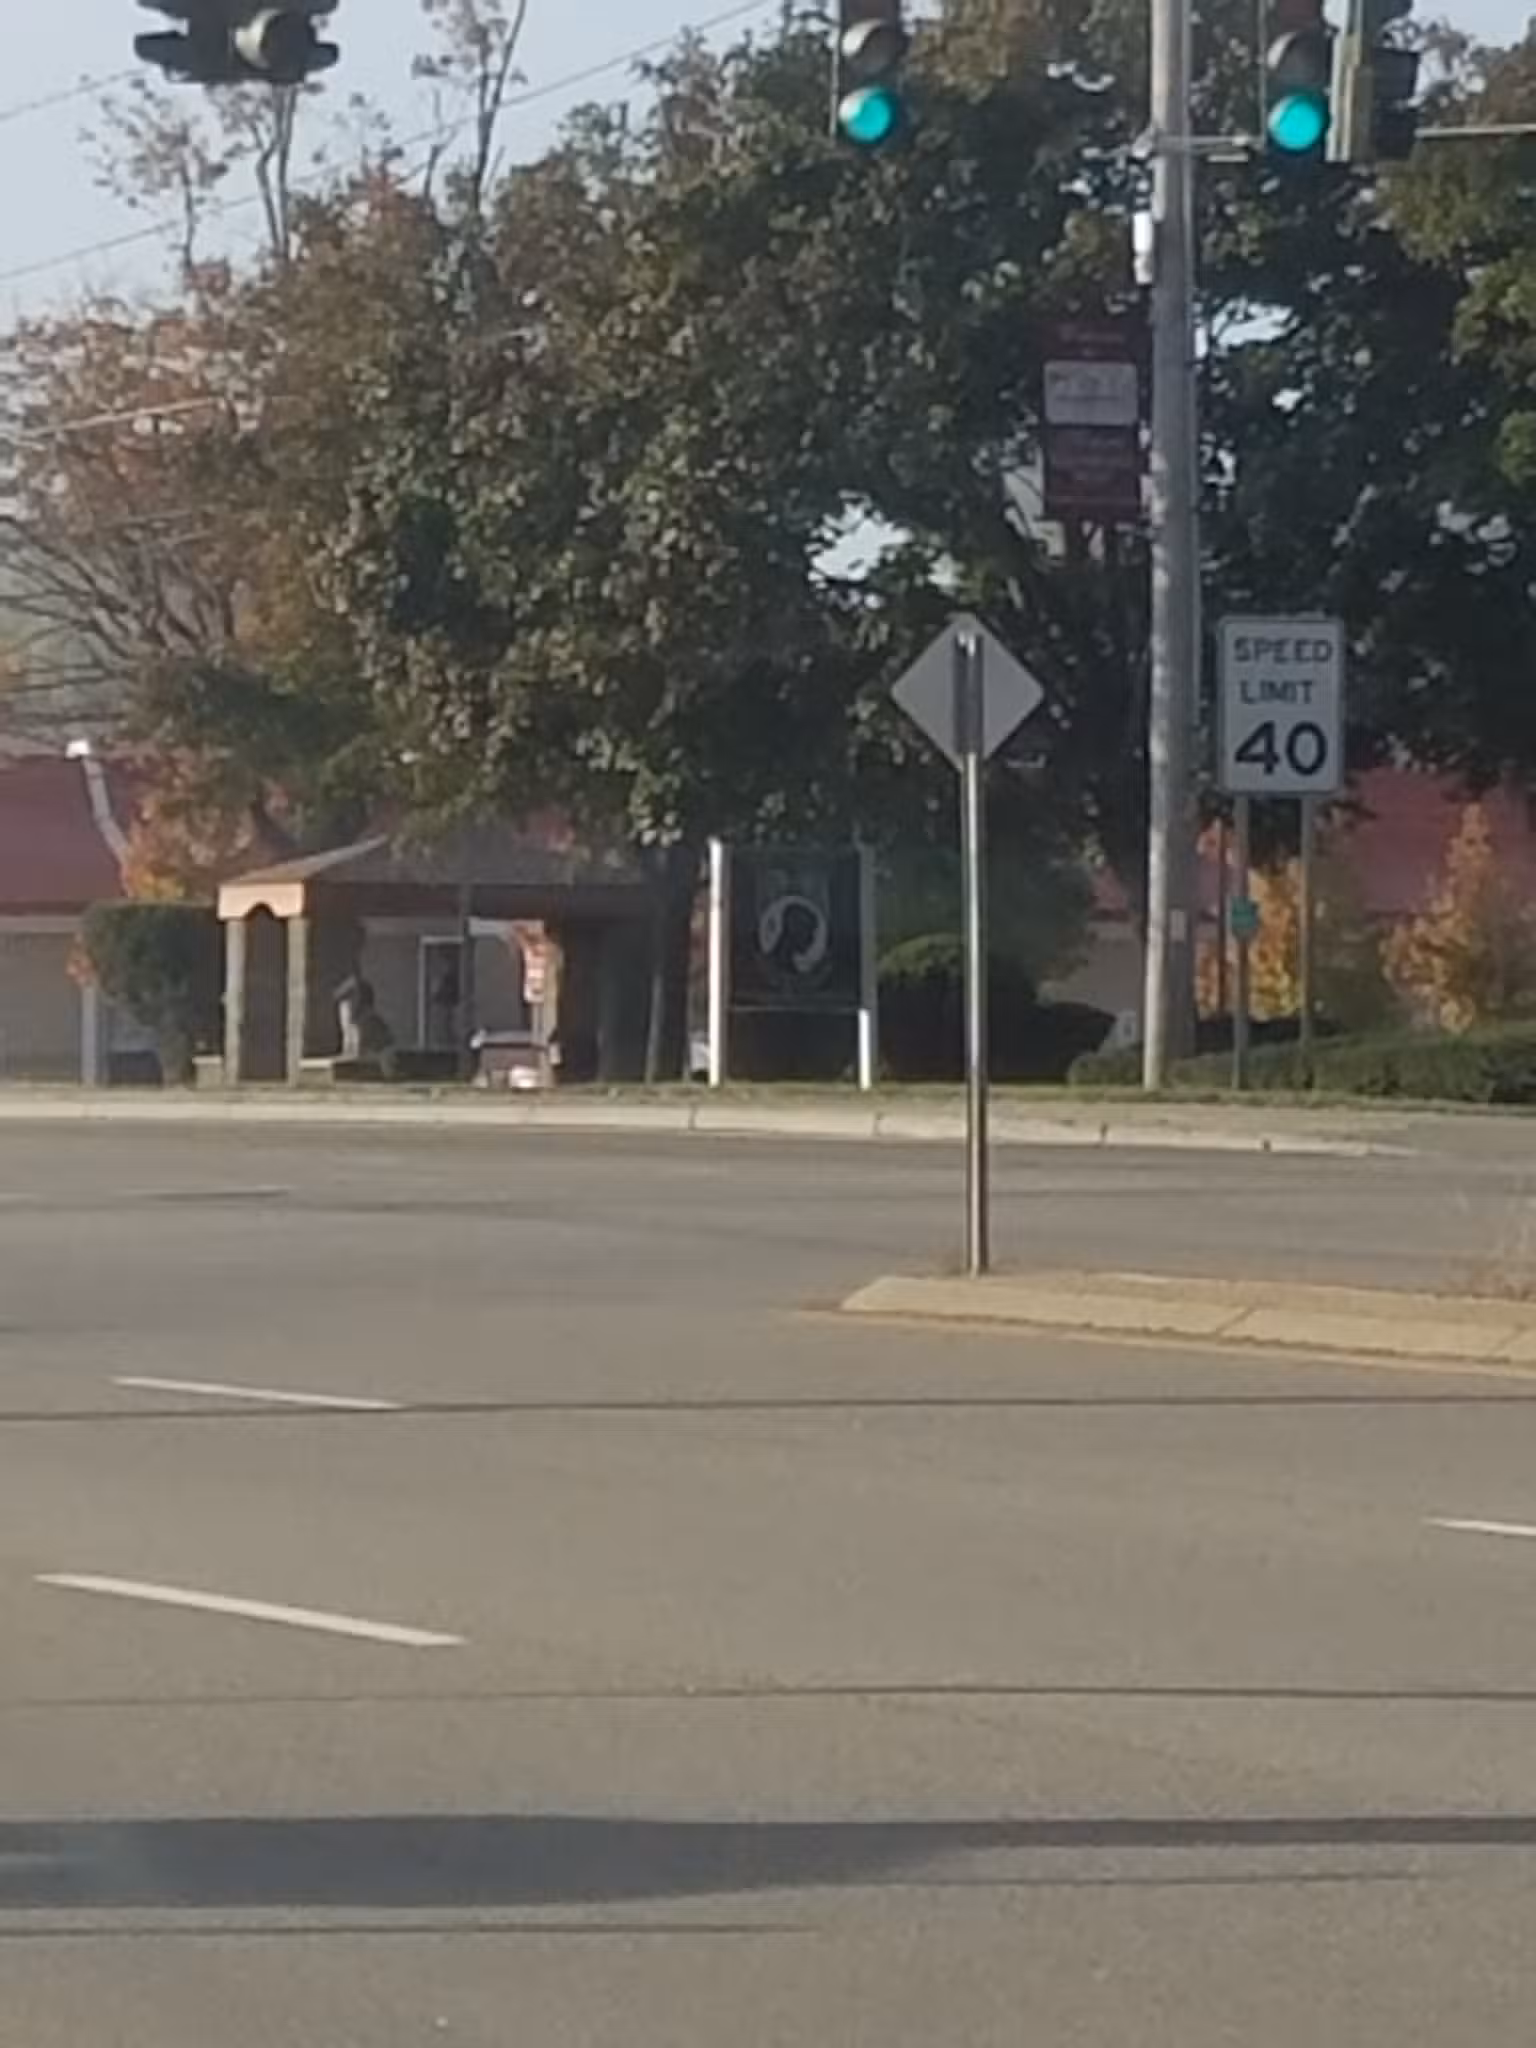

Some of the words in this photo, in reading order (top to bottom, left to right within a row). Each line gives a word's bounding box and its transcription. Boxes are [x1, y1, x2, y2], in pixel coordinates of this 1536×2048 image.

[1233, 637, 1333, 663] SPEED
[1240, 680, 1313, 704] LIMIT
[1235, 720, 1328, 776] 40
